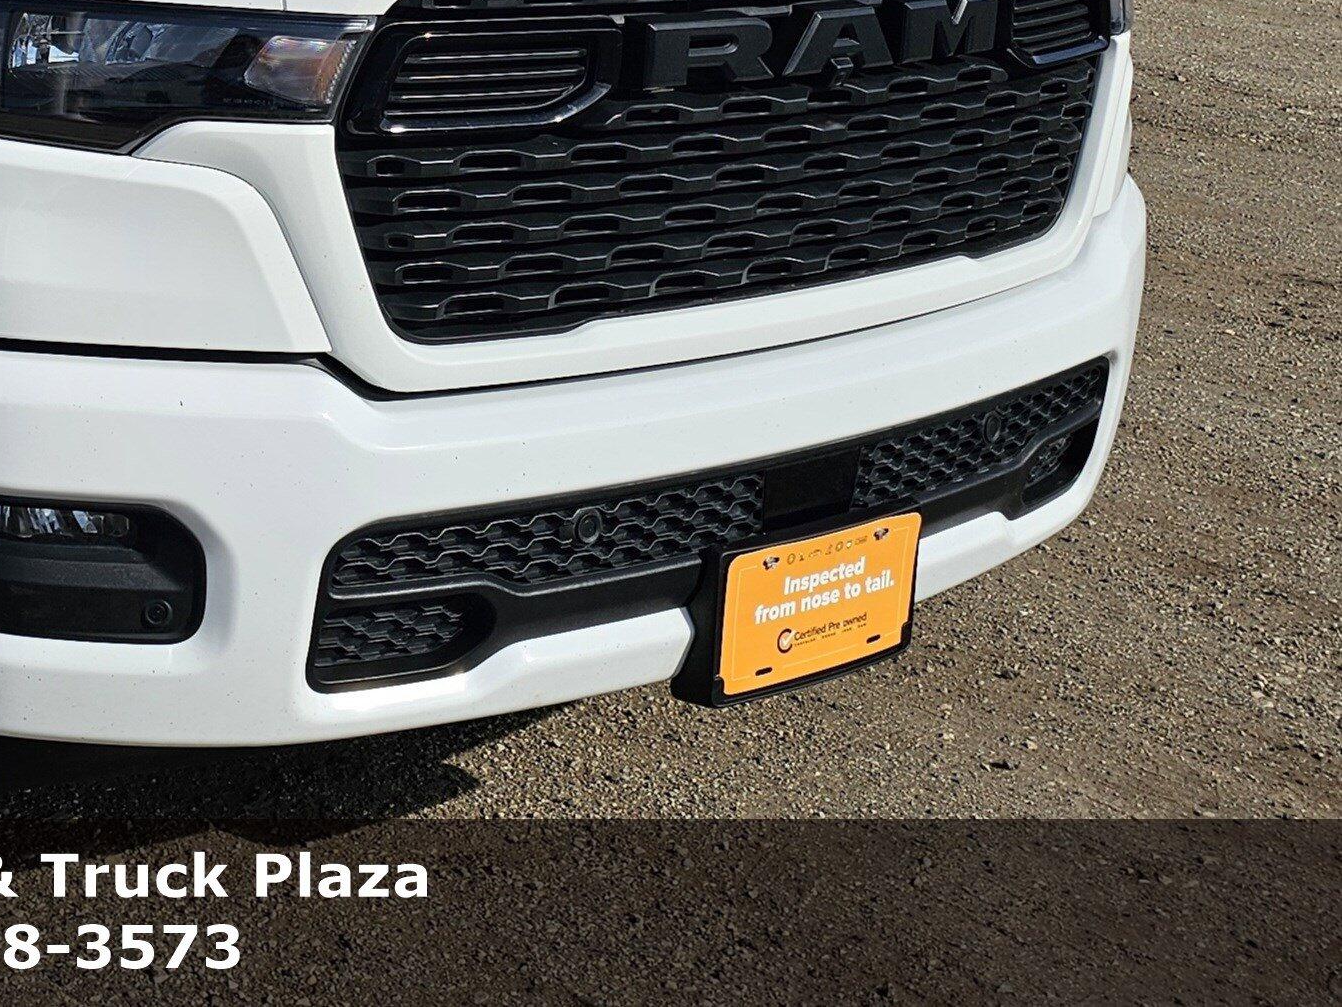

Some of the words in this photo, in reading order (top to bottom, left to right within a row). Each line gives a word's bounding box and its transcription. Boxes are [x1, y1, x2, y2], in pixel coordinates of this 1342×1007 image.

[784, 556, 866, 594] Inspected
[754, 600, 796, 625] from
[800, 588, 840, 612] nose
[844, 582, 861, 599] to
[865, 569, 895, 593] tail.
[794, 624, 827, 641] Certified
[828, 621, 841, 631] Pre
